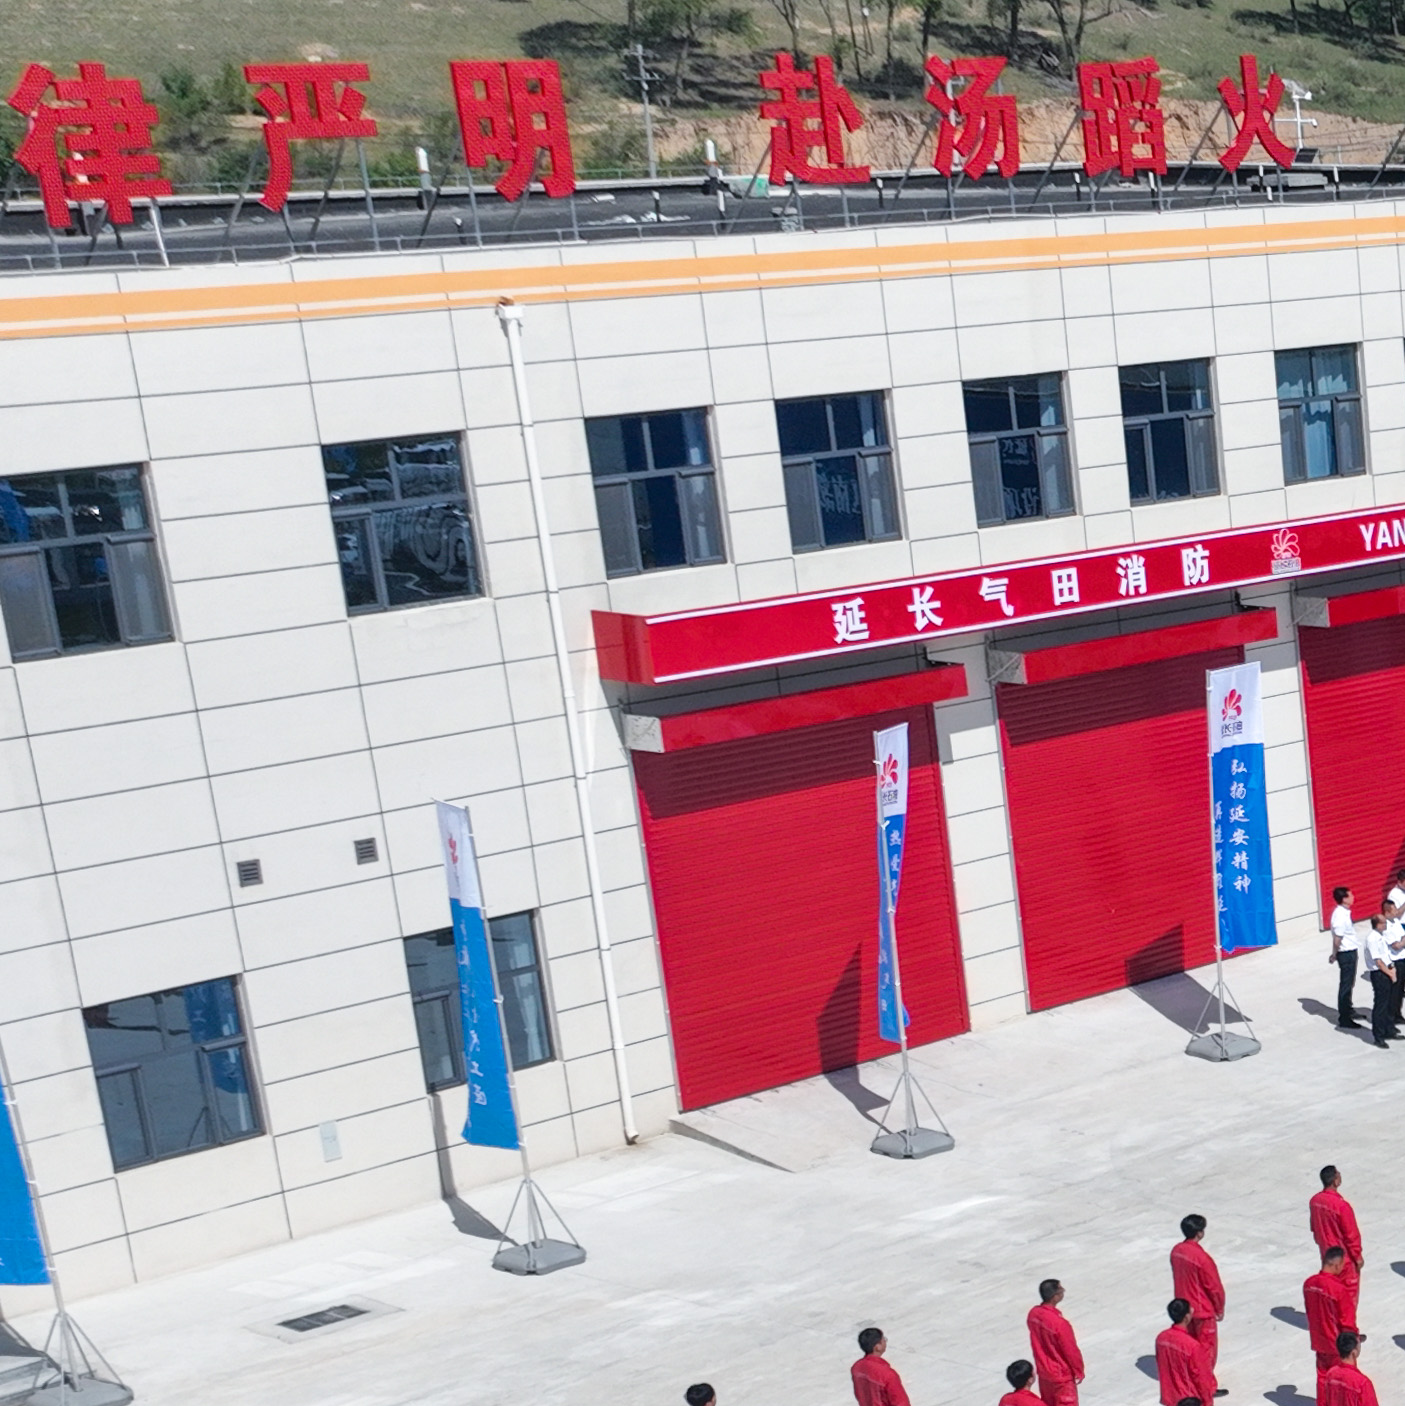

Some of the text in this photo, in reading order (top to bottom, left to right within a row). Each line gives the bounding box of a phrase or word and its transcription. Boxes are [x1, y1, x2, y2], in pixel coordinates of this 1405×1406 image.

[760, 53, 1296, 186] 赴汤蹈火
[832, 545, 1210, 644] 延长气田消防
[1229, 759, 1252, 895] 弘扬延安精神
